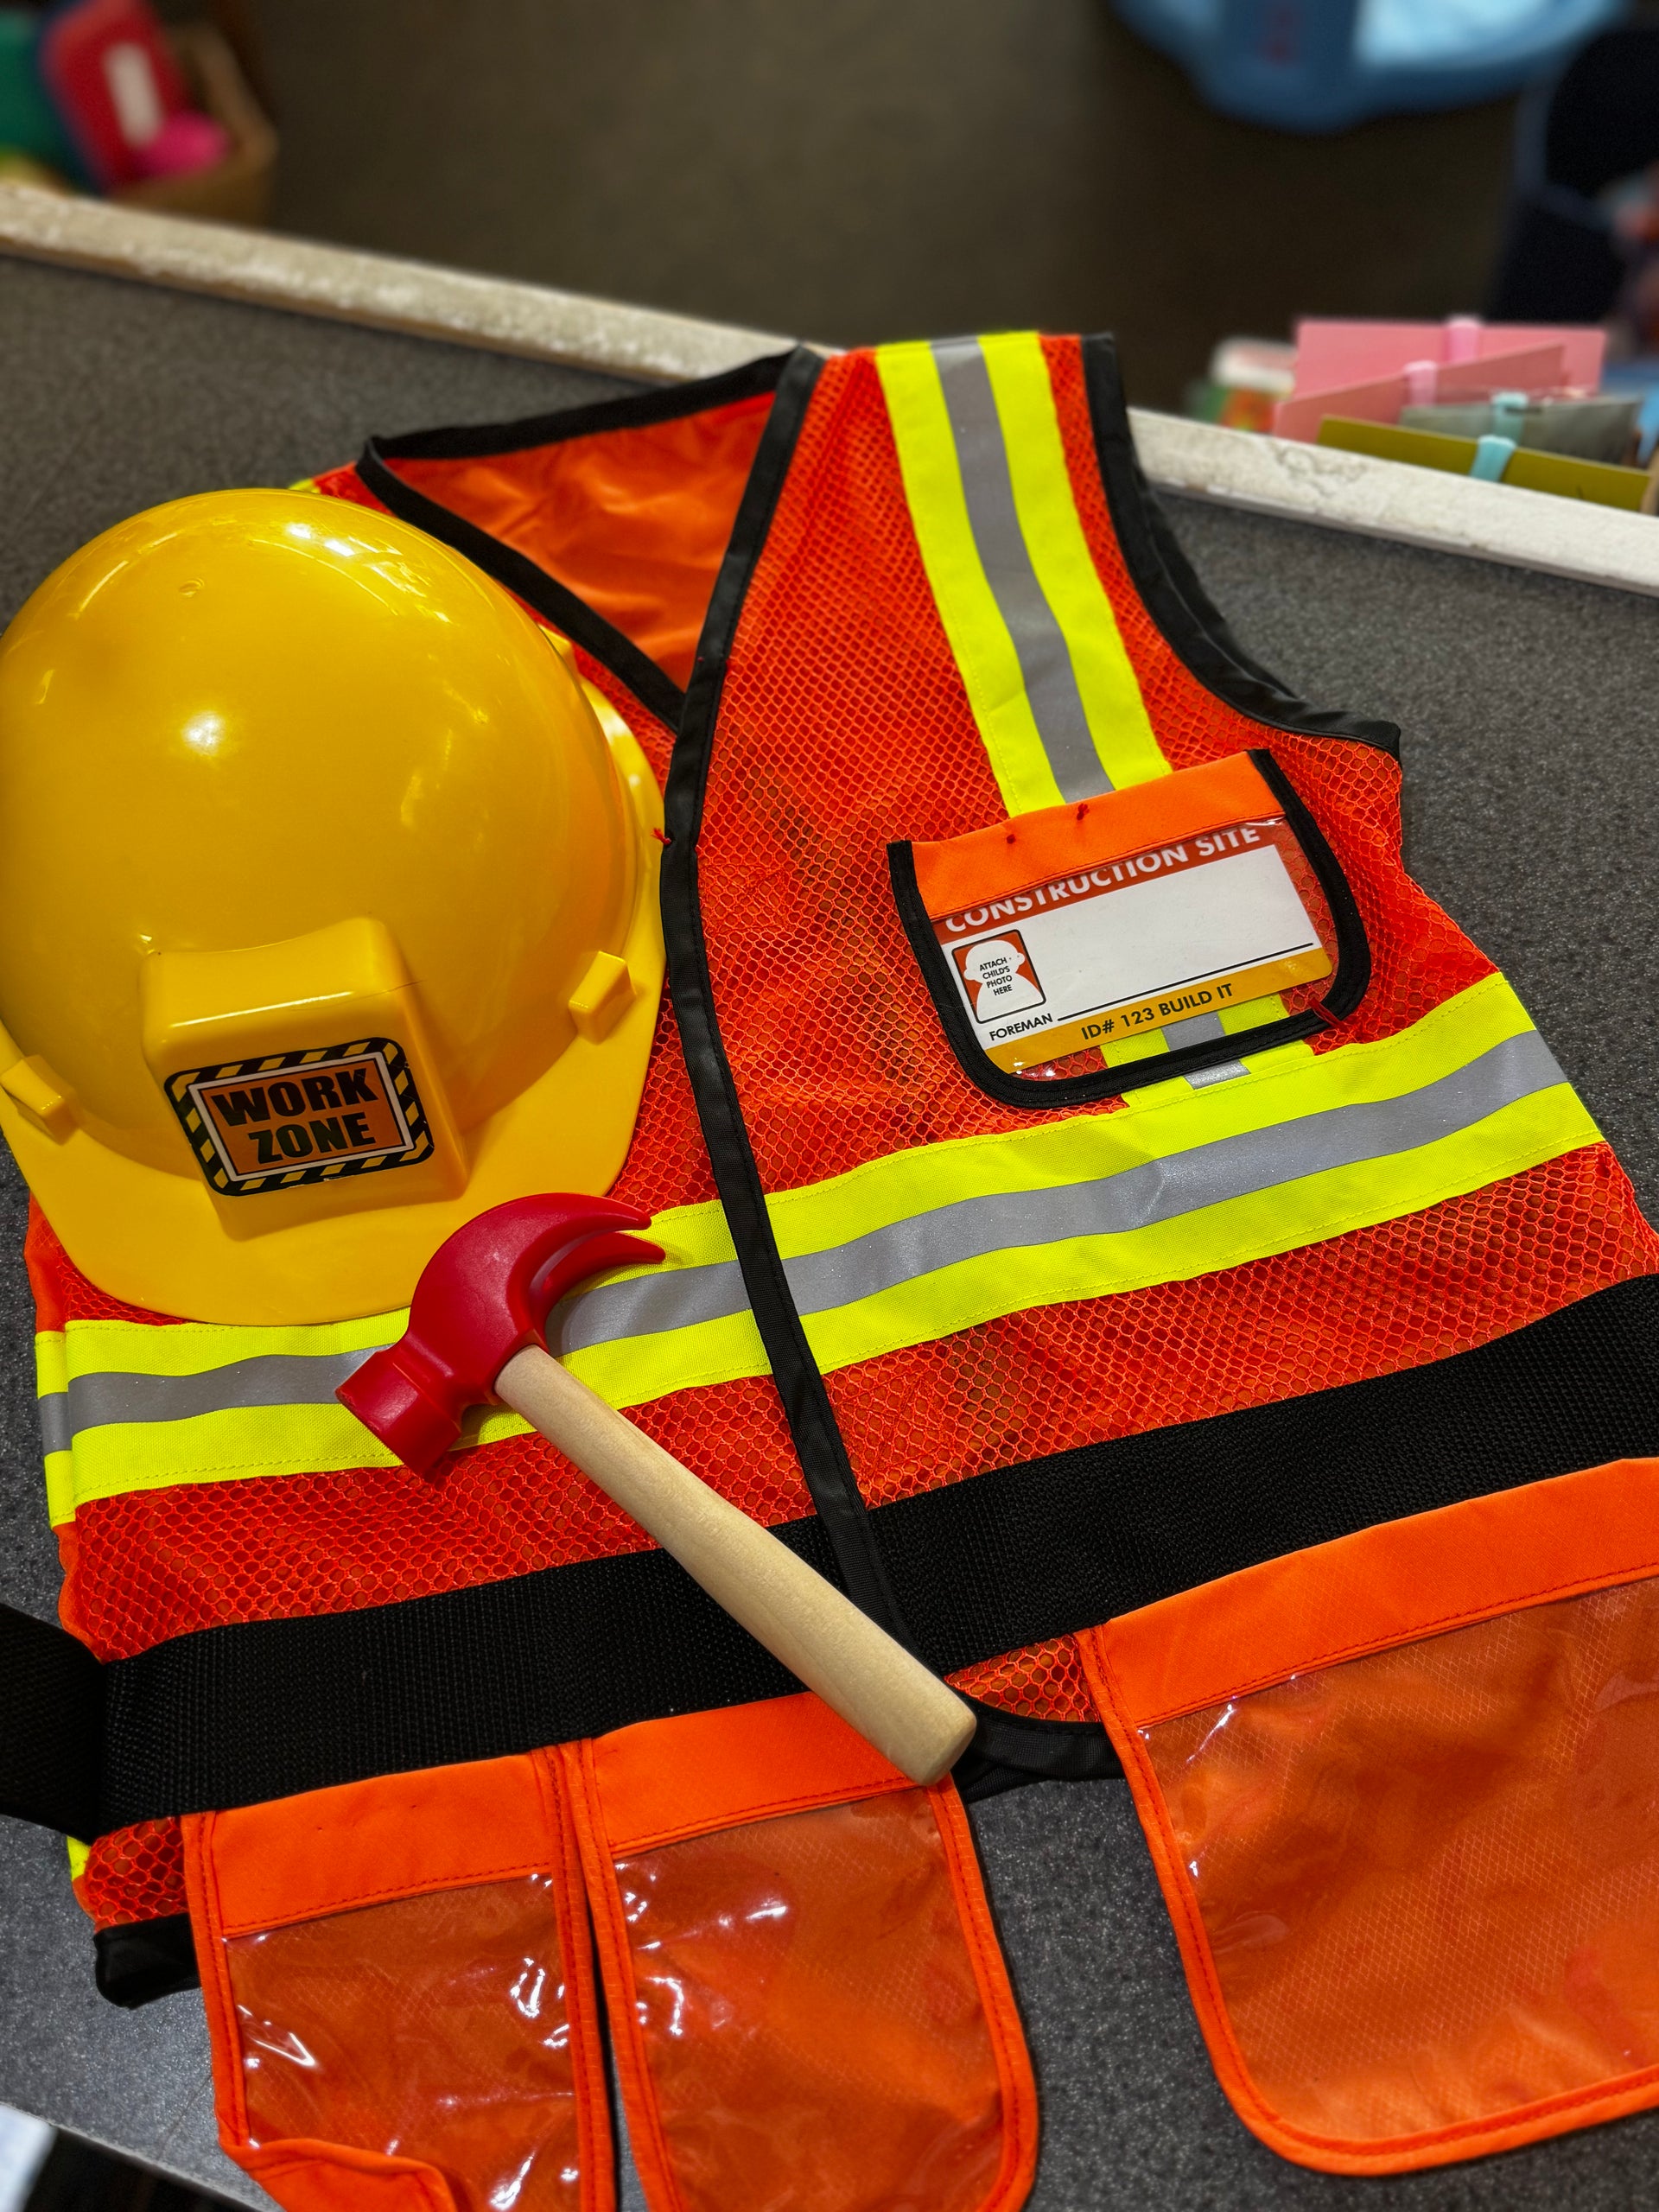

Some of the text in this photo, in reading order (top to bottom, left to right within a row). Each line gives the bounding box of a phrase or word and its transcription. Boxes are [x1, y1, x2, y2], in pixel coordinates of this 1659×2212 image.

[945, 827, 1261, 932] CONSTRUCTION SITE
[979, 957, 1007, 971] ATTACH
[982, 965, 1011, 980] CHILD'S
[986, 975, 1013, 988] PHOTO
[993, 984, 1013, 996] HERE
[1081, 982, 1234, 1040] ID# 123 BUILD IT
[988, 1013, 1053, 1041] FOREMAN
[211, 1067, 378, 1127] WORK
[247, 1111, 377, 1165] ZONE
